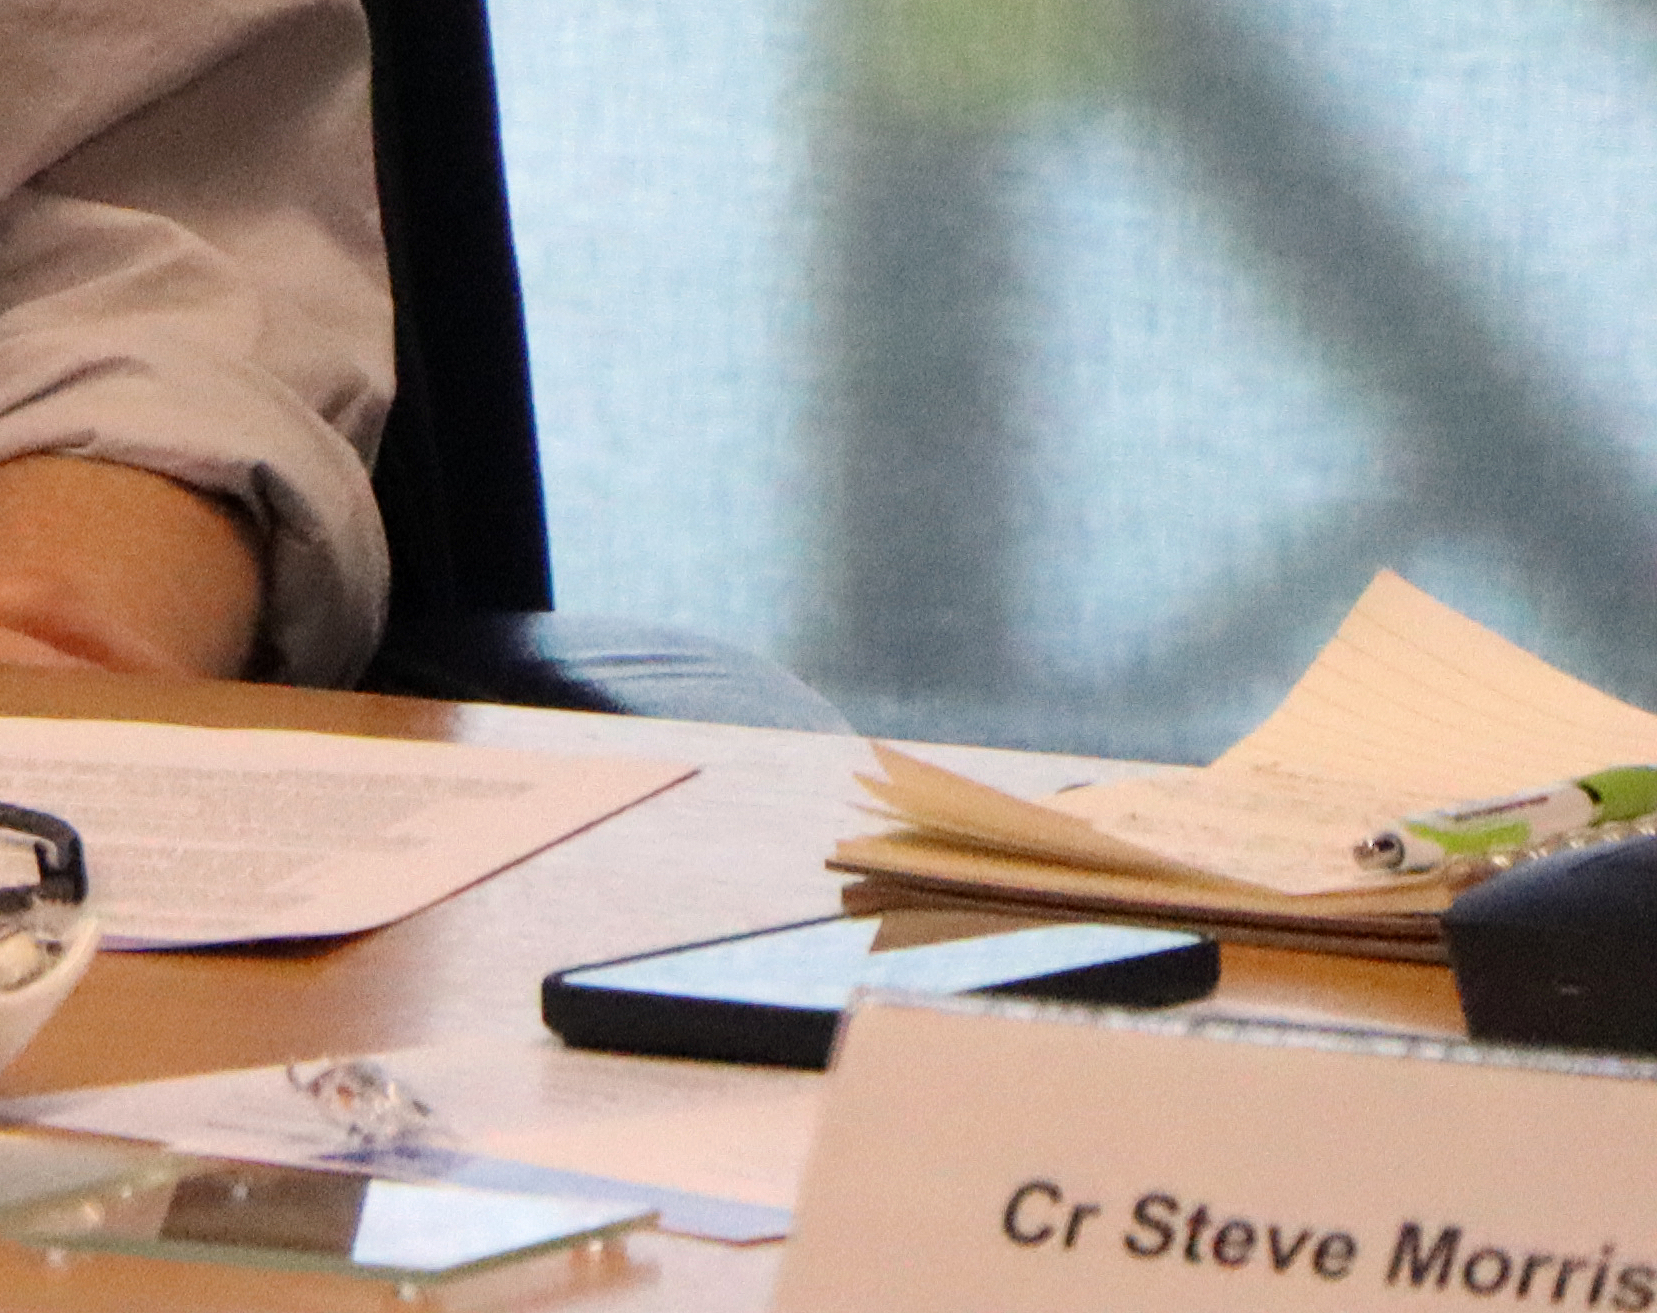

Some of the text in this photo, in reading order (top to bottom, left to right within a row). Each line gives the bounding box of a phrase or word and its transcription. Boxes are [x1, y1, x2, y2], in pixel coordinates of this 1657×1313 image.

[1002, 1180, 1657, 1313] Cr Steve Morris
